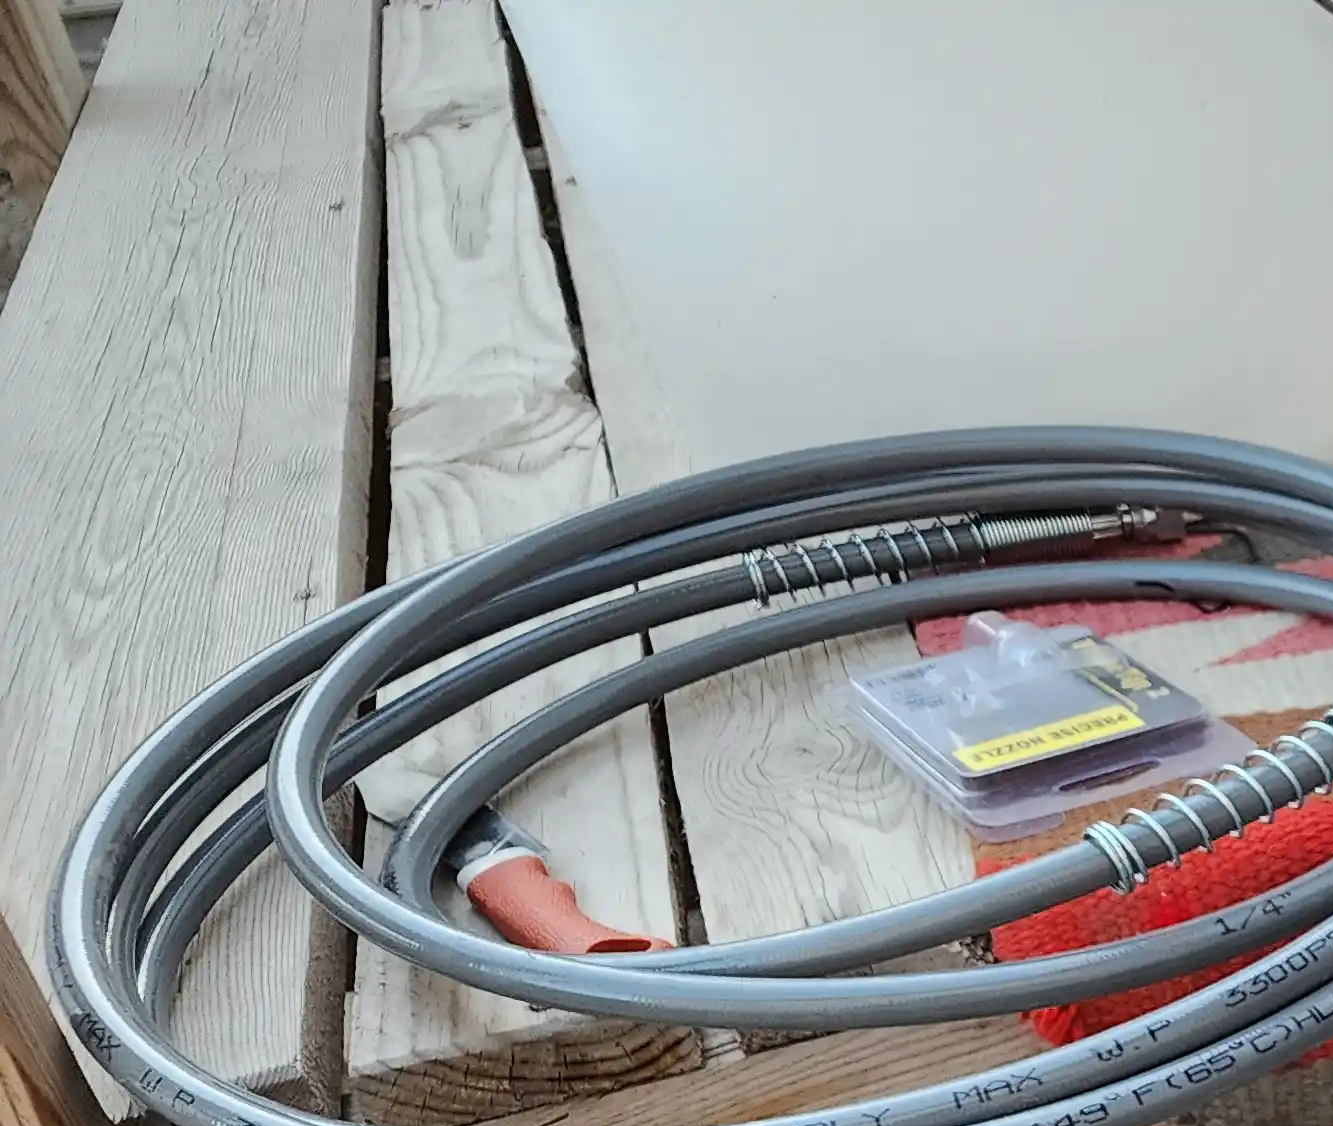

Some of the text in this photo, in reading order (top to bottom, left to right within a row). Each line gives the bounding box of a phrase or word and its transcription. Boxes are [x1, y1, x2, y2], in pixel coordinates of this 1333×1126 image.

[971, 712, 1129, 763] PRECISE NOZZLE
[79, 1011, 122, 1062] MAX
[952, 1067, 1044, 1110] MAX
